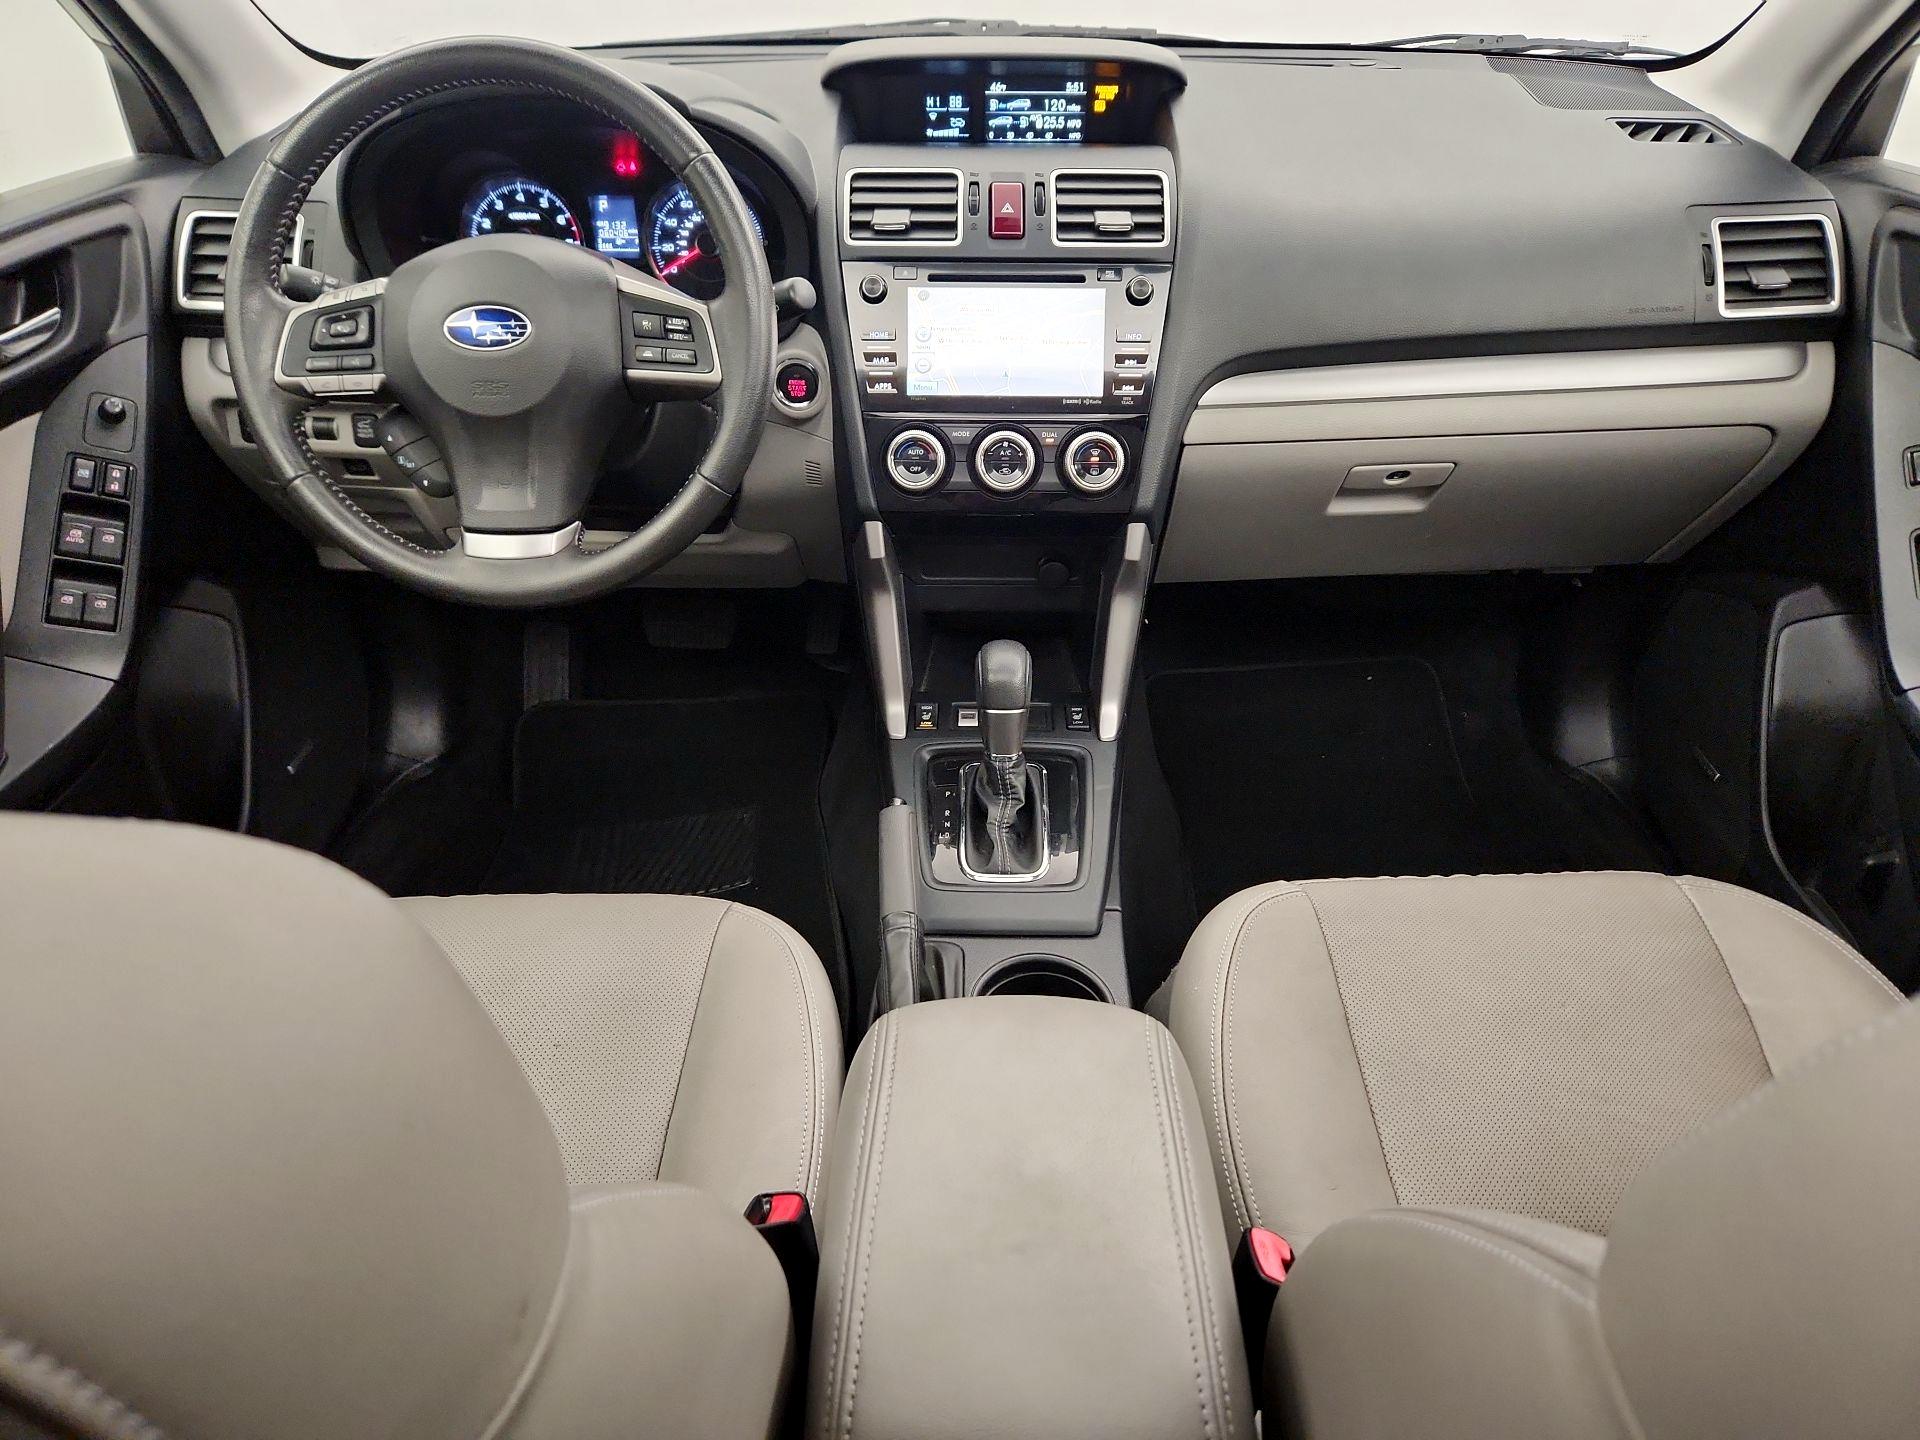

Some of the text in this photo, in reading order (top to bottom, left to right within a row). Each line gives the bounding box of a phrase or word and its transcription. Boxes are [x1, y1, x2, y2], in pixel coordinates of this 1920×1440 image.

[1045, 99, 1067, 112] 120
[680, 200, 693, 208] 60
[665, 218, 678, 227] 40
[661, 243, 675, 252] 20
[869, 331, 889, 339] HOME
[872, 356, 890, 365] MAP
[874, 382, 892, 391] APPS
[944, 809, 951, 817] R
